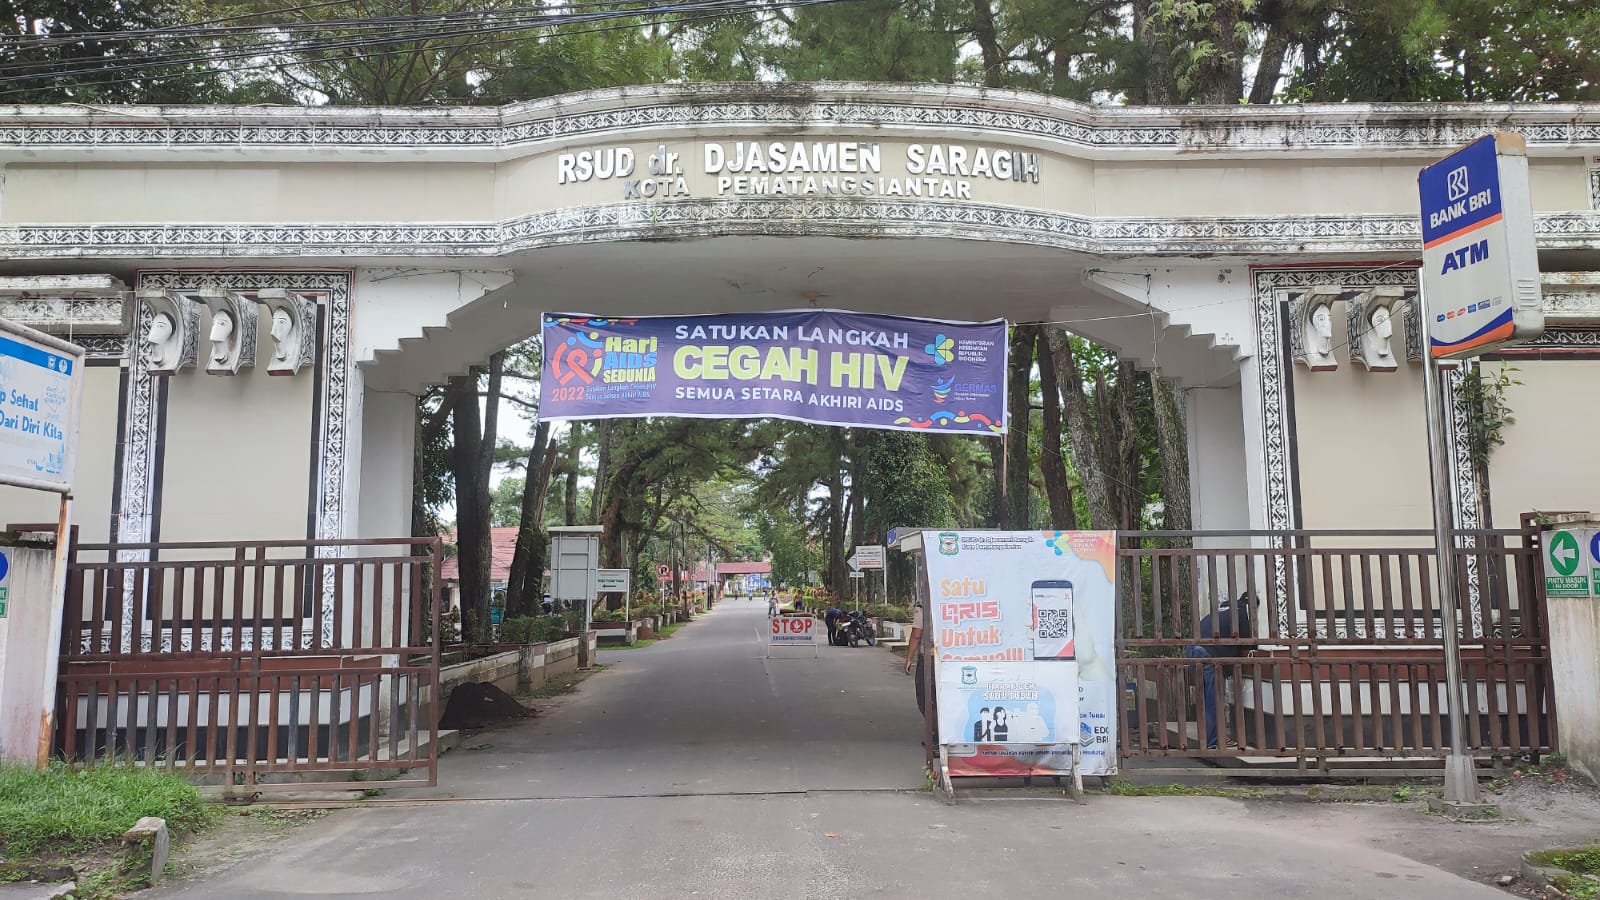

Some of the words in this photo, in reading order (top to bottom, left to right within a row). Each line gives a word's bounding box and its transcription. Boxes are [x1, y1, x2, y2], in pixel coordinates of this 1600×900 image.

[558, 147, 635, 184] RSUD
[648, 146, 684, 176] dr.
[704, 142, 881, 174] DJASAMEN
[905, 143, 1040, 184] SARAGIH
[624, 176, 691, 199] KOTA
[717, 176, 972, 199] PEMATANGSIANTAR
[1430, 200, 1467, 229] BANK
[1469, 188, 1492, 213] BRI
[1441, 239, 1489, 275] ATM
[605, 336, 658, 353] Hari
[675, 325, 788, 341] SATUKAN
[798, 326, 909, 349] LANGKAH
[603, 352, 658, 369] AIDS
[673, 345, 819, 385] CEGAH
[830, 351, 909, 391] HIV
[603, 367, 656, 384] SEDUNIA
[11, 388, 39, 411] Sehat
[552, 386, 585, 402] 2022
[675, 387, 735, 400] SEMUA
[741, 388, 803, 403] SETARA
[808, 393, 862, 409] AKHIRI
[867, 398, 904, 412] AIDS
[954, 383, 998, 393] GERMAS
[0, 410, 18, 429] Dari
[22, 416, 41, 435] Diri
[43, 421, 63, 440] Kita
[941, 576, 985, 597] Satu
[1565, 576, 1586, 584] MASUK
[942, 601, 999, 625] QRIS
[772, 618, 812, 634] STOP
[941, 624, 1000, 648] Untuk
[1096, 736, 1109, 744] BRI
